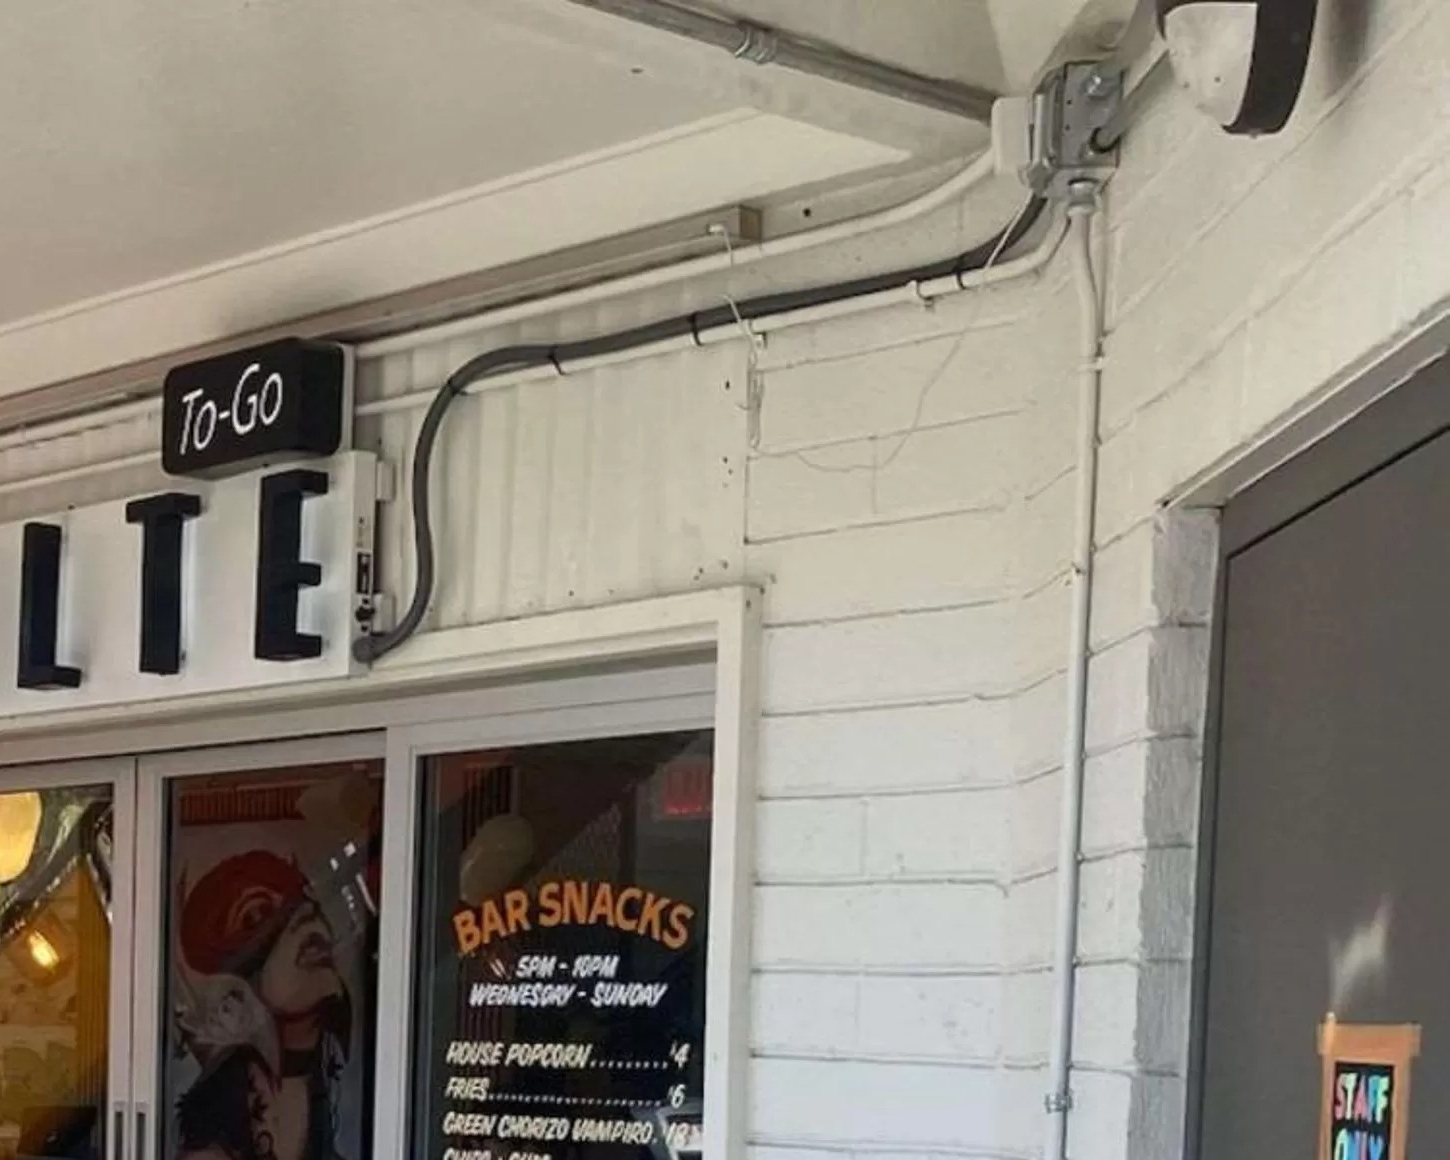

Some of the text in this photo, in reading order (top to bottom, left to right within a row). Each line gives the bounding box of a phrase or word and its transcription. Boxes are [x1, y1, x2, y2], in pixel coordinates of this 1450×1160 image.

[179, 364, 284, 457] To-Go
[452, 879, 696, 954] BAR SNACKS
[515, 954, 557, 979] 5PM
[572, 954, 620, 979] 10PM
[469, 982, 577, 1007] WEDNESDAY
[590, 982, 669, 1008] SUNDAY
[446, 1041, 504, 1067] HOUSE
[1334, 1072, 1390, 1124] STAFF
[442, 1111, 496, 1137] GREEN
[497, 1114, 570, 1141] CHORIZO
[663, 1121, 690, 1147] 18
